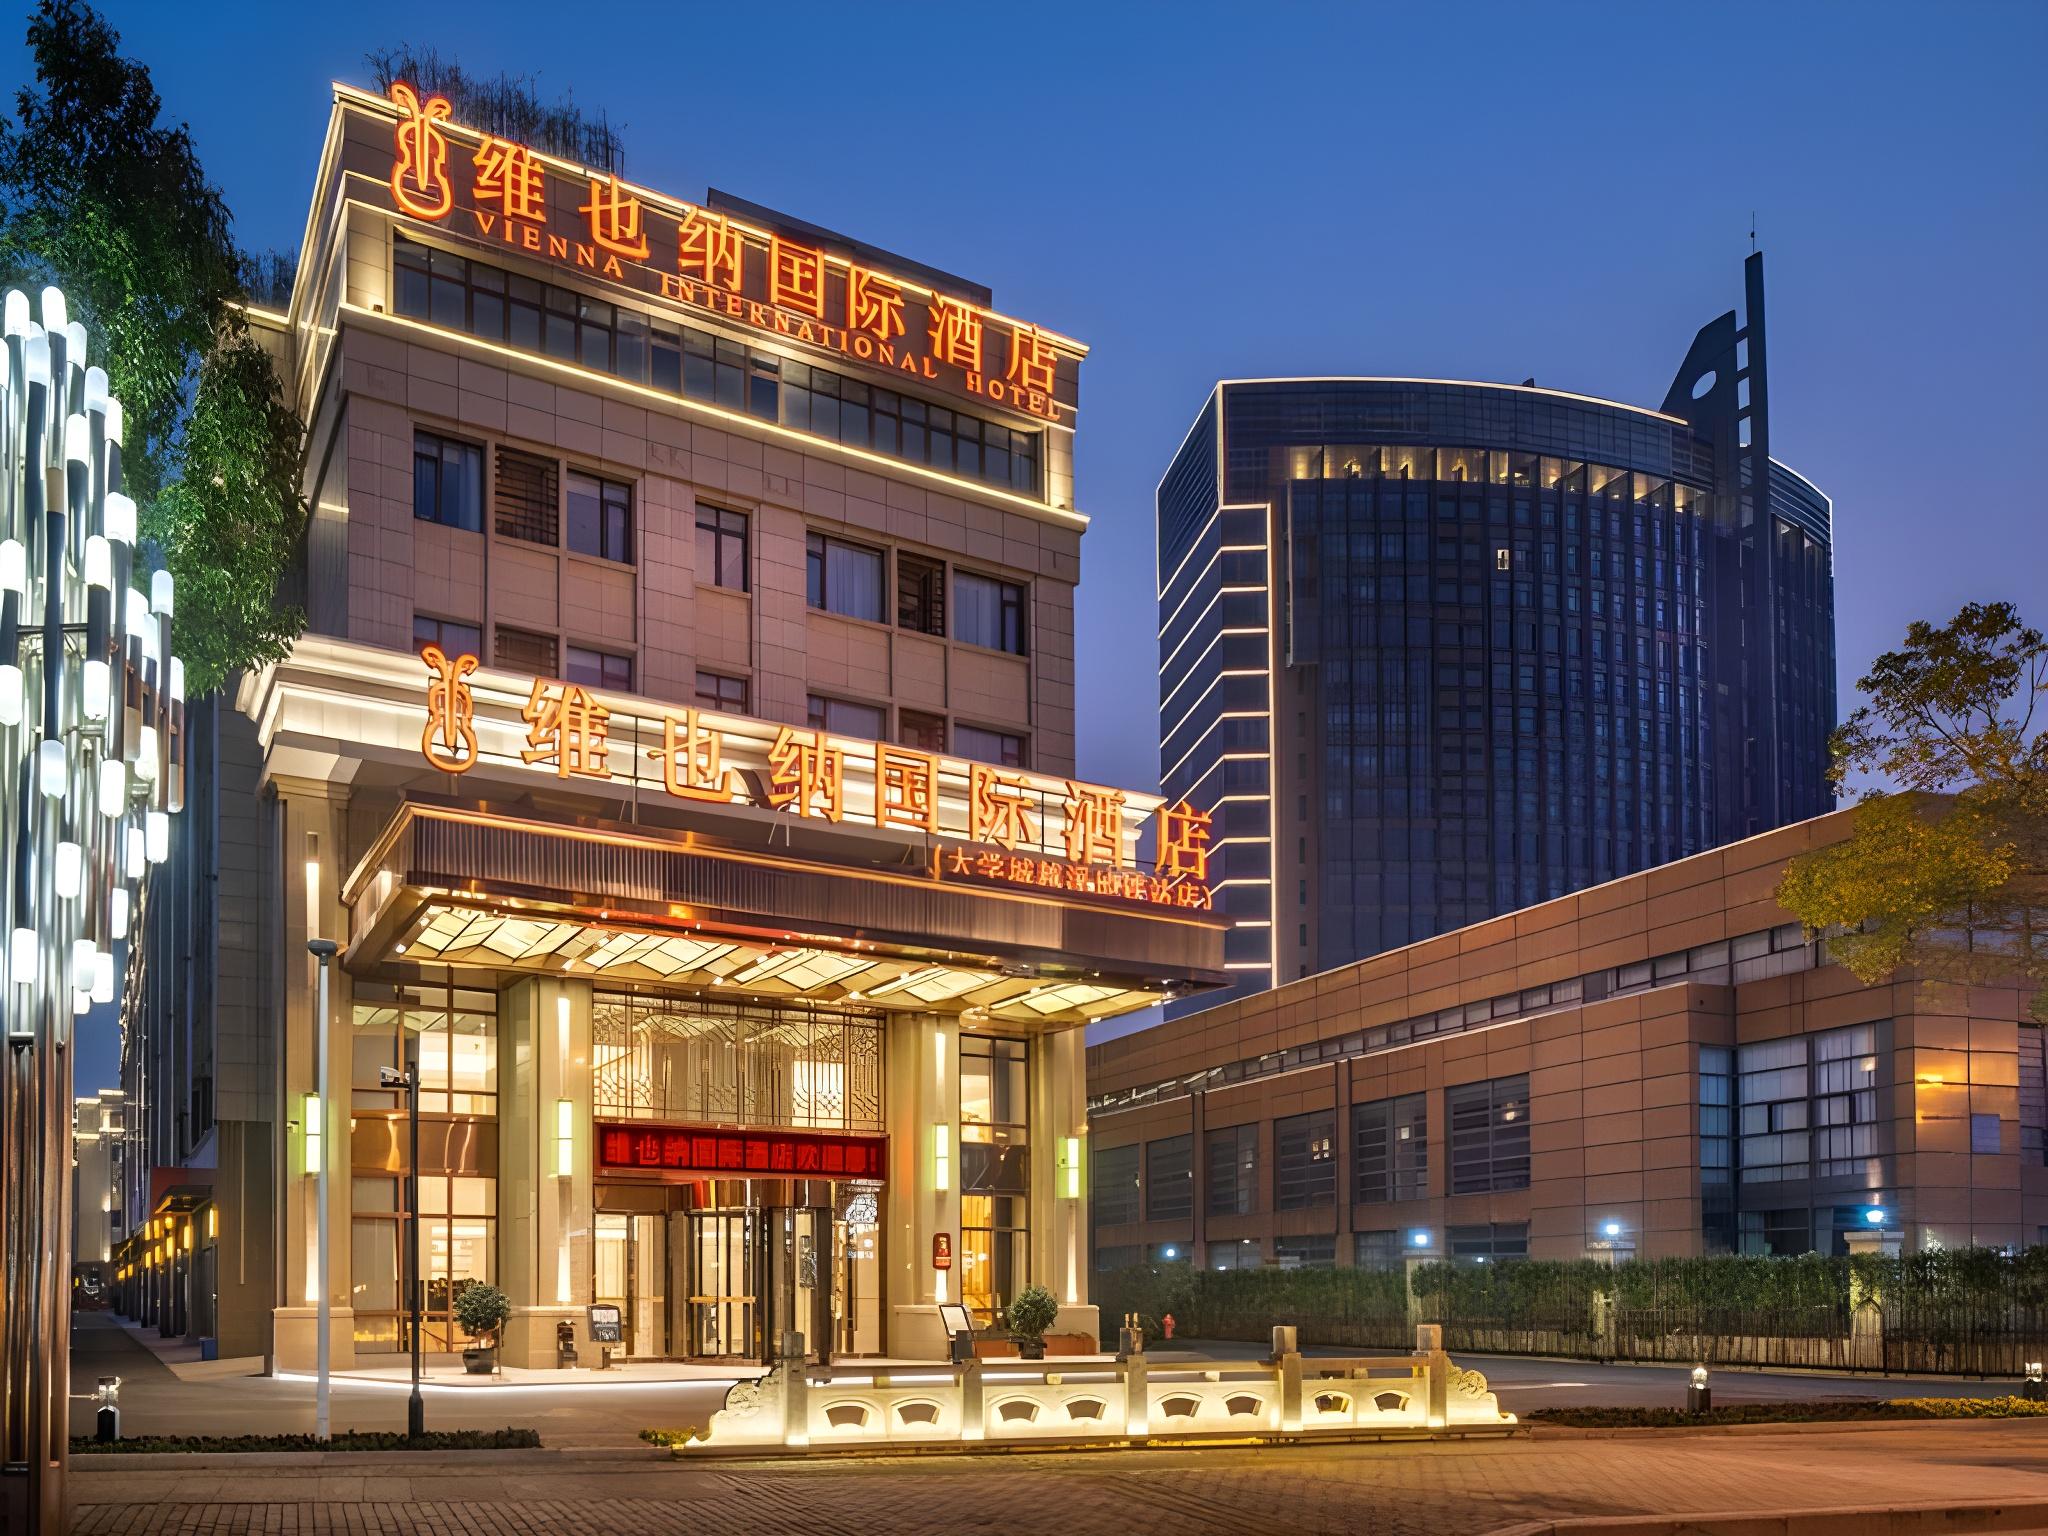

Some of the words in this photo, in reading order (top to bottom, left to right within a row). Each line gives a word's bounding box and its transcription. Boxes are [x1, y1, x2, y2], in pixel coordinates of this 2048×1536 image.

[472, 137, 1060, 394] 维也纳国际酒店
[474, 210, 624, 279] VIENNA
[660, 272, 938, 379] INTERNATIONAL
[965, 371, 1061, 421] HOTEL
[520, 676, 1213, 879] 维也纳国际酒店
